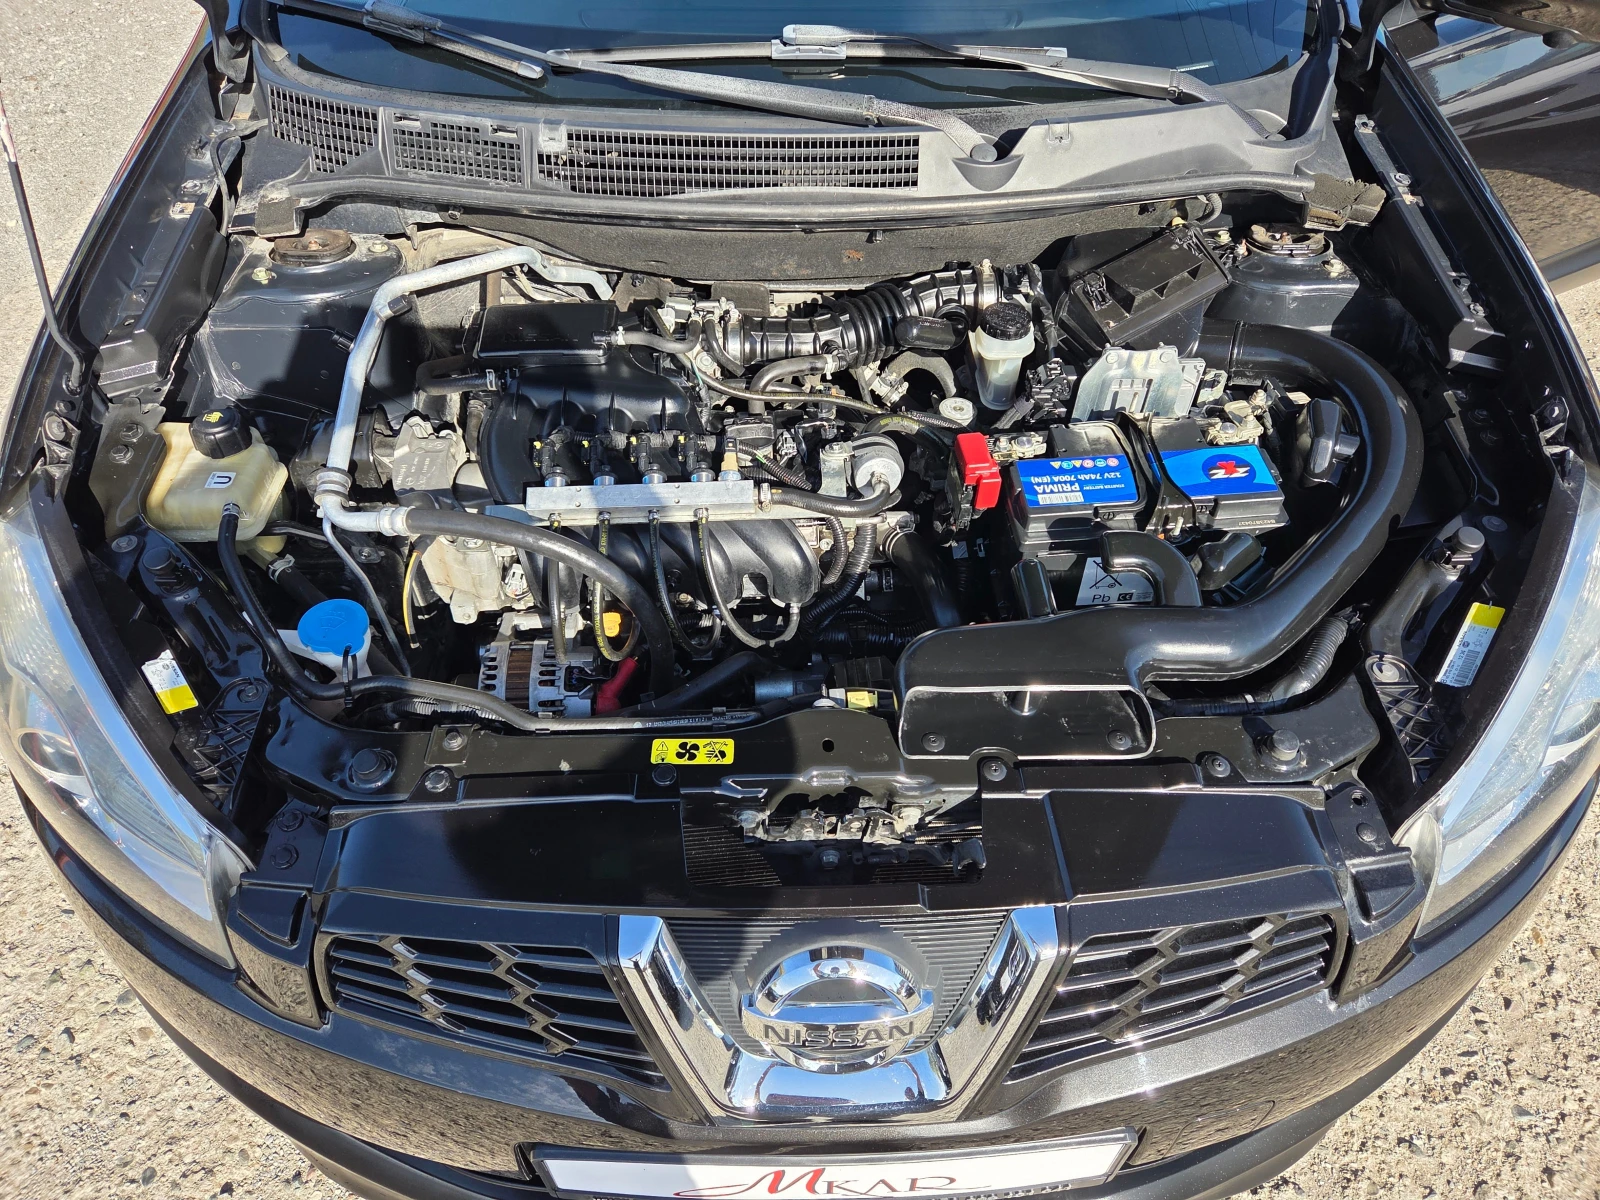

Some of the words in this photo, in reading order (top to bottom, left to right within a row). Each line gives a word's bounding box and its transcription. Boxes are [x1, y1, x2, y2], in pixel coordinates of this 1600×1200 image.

[1031, 475, 1051, 484] (EN)
[1033, 482, 1080, 494] PRIMA
[1092, 593, 1111, 603] Pb
[762, 1021, 914, 1048] NISSAN
